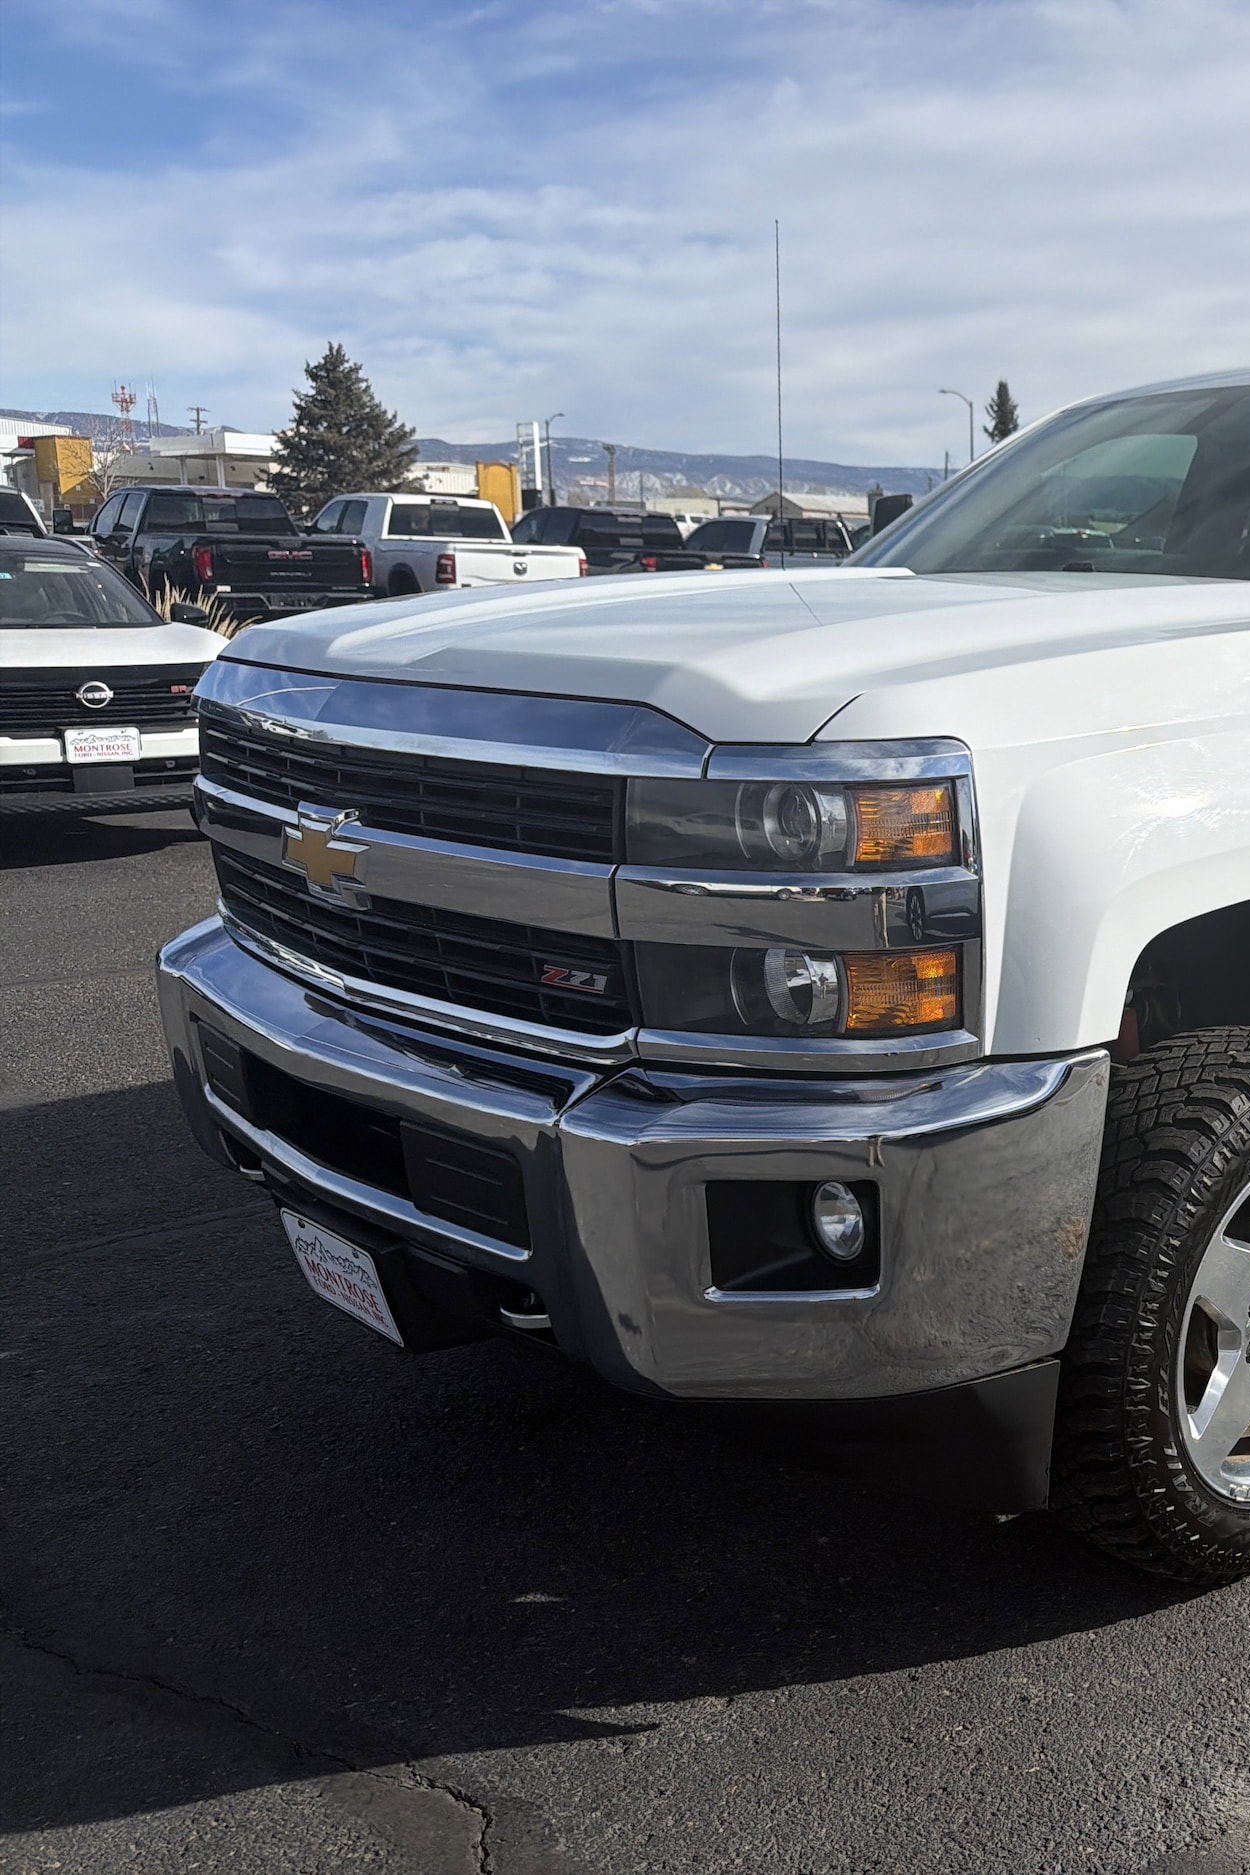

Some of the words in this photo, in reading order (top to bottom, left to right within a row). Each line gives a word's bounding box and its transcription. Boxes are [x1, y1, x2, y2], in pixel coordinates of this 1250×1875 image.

[76, 690, 114, 699] NISSAN
[73, 743, 133, 753] MONTROSE
[541, 964, 608, 995] Z71
[304, 1255, 384, 1314] MONTROSE
